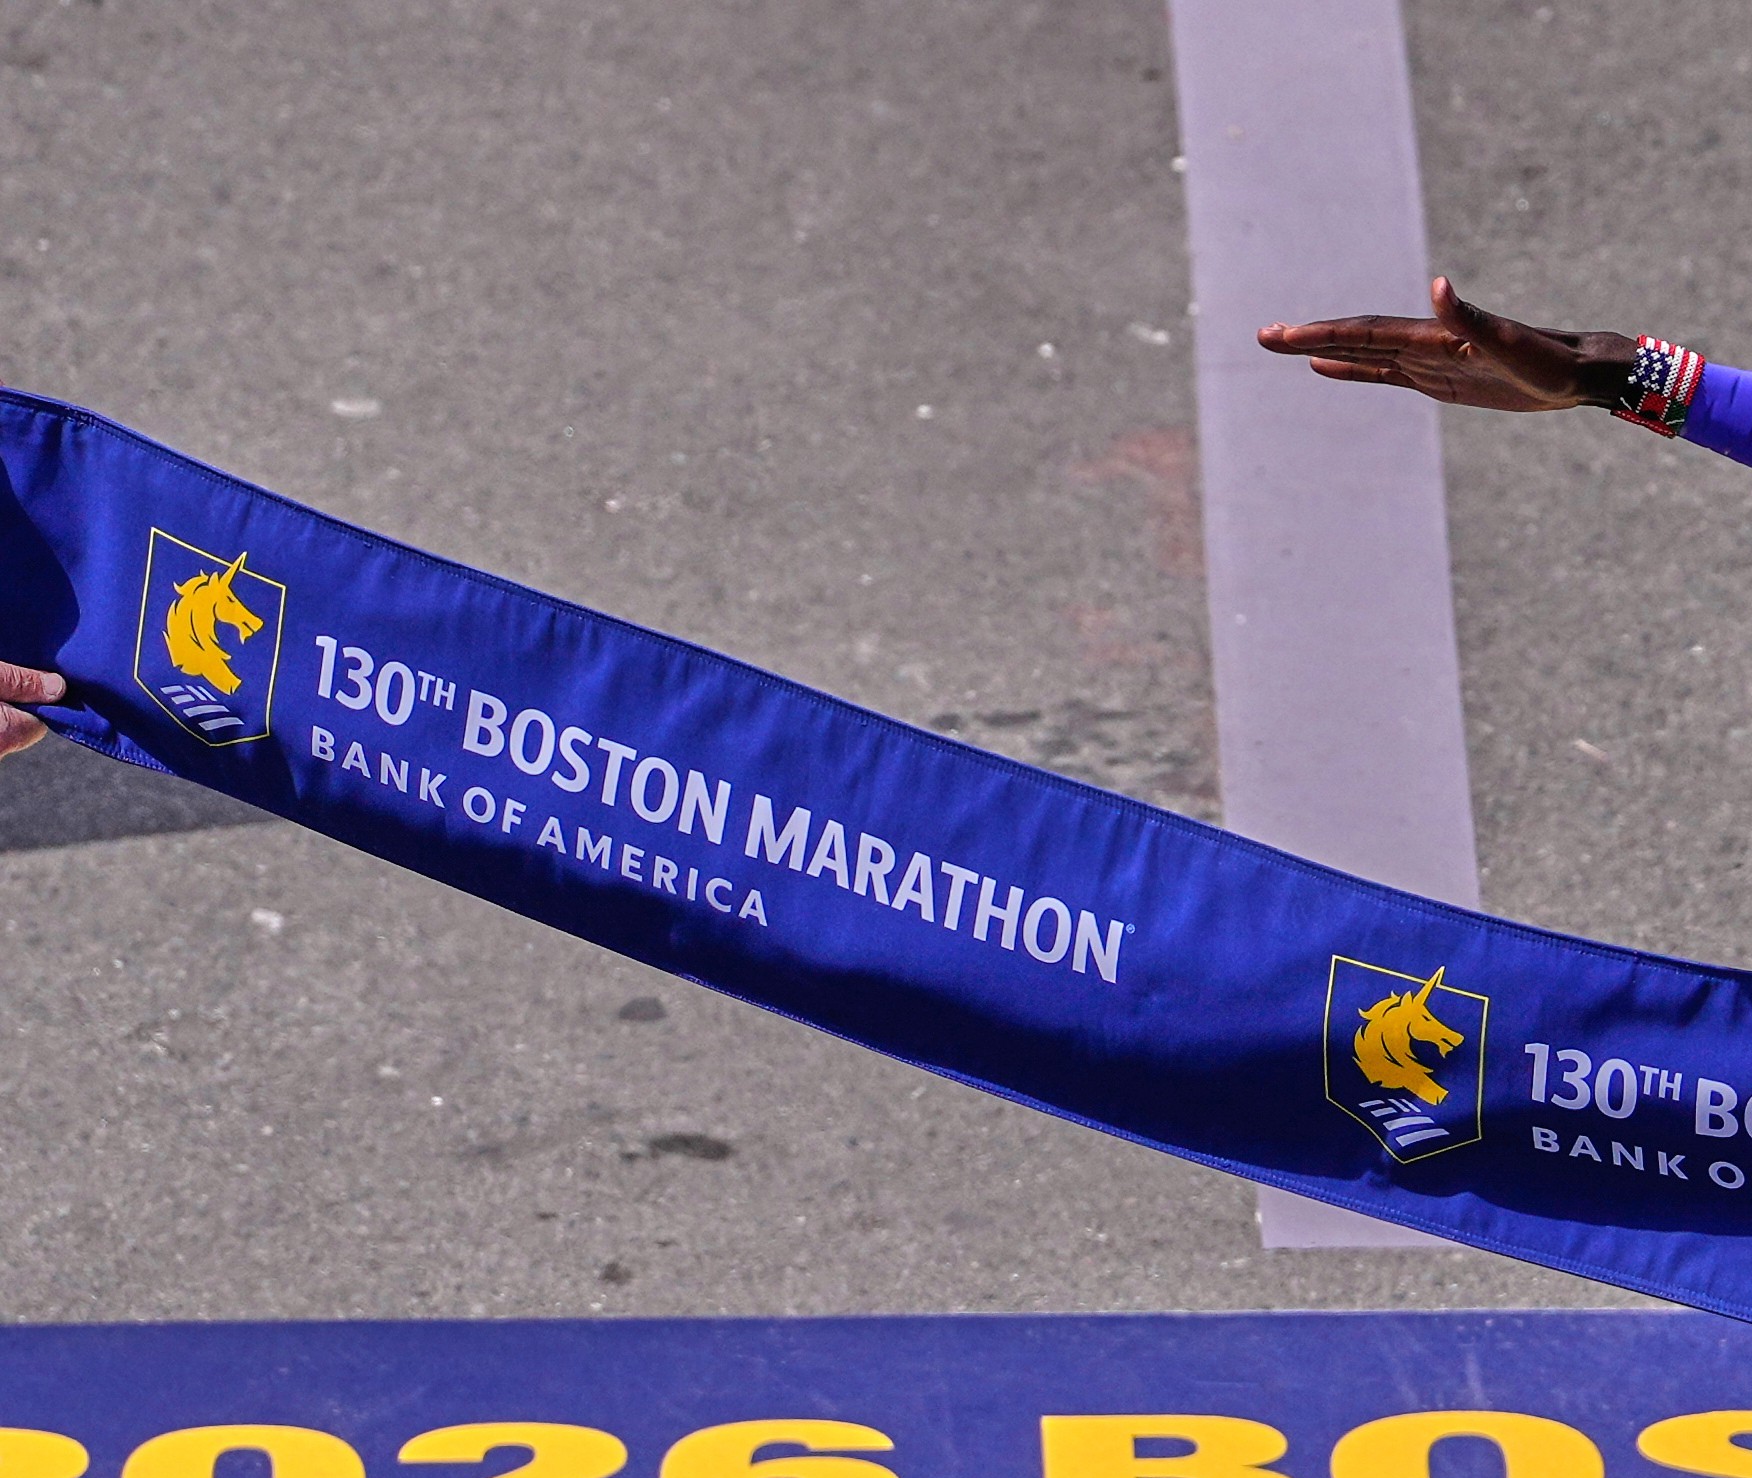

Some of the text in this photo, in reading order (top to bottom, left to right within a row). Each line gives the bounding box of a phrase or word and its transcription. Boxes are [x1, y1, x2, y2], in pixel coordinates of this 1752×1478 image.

[310, 724, 769, 928] BANK OF AMERICA
[314, 634, 1126, 985] 130TH BOSTON MARATHON
[1523, 1041, 1684, 1120] 130TH
[1531, 1125, 1690, 1181] BANK
